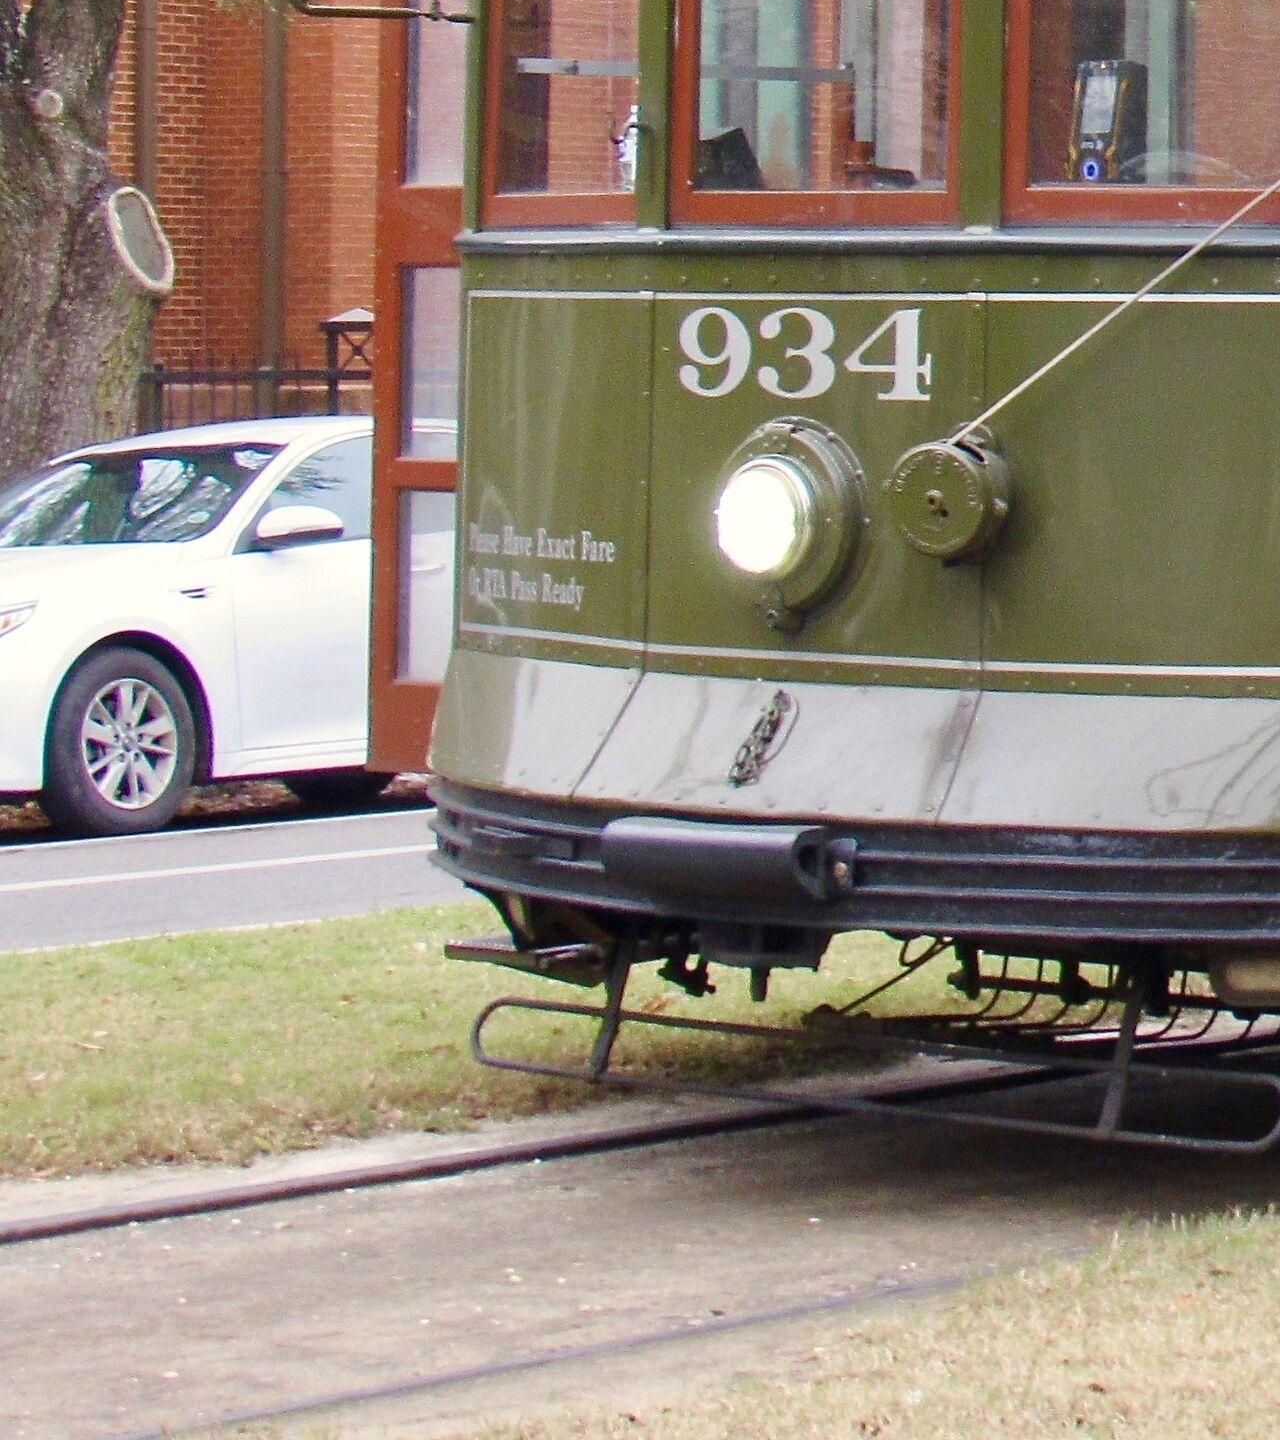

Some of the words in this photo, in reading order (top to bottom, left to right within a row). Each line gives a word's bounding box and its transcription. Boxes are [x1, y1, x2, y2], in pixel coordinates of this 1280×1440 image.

[678, 305, 932, 403] 934
[536, 528, 576, 560] Exact
[580, 530, 618, 562] Fare
[541, 573, 585, 611] Ready
